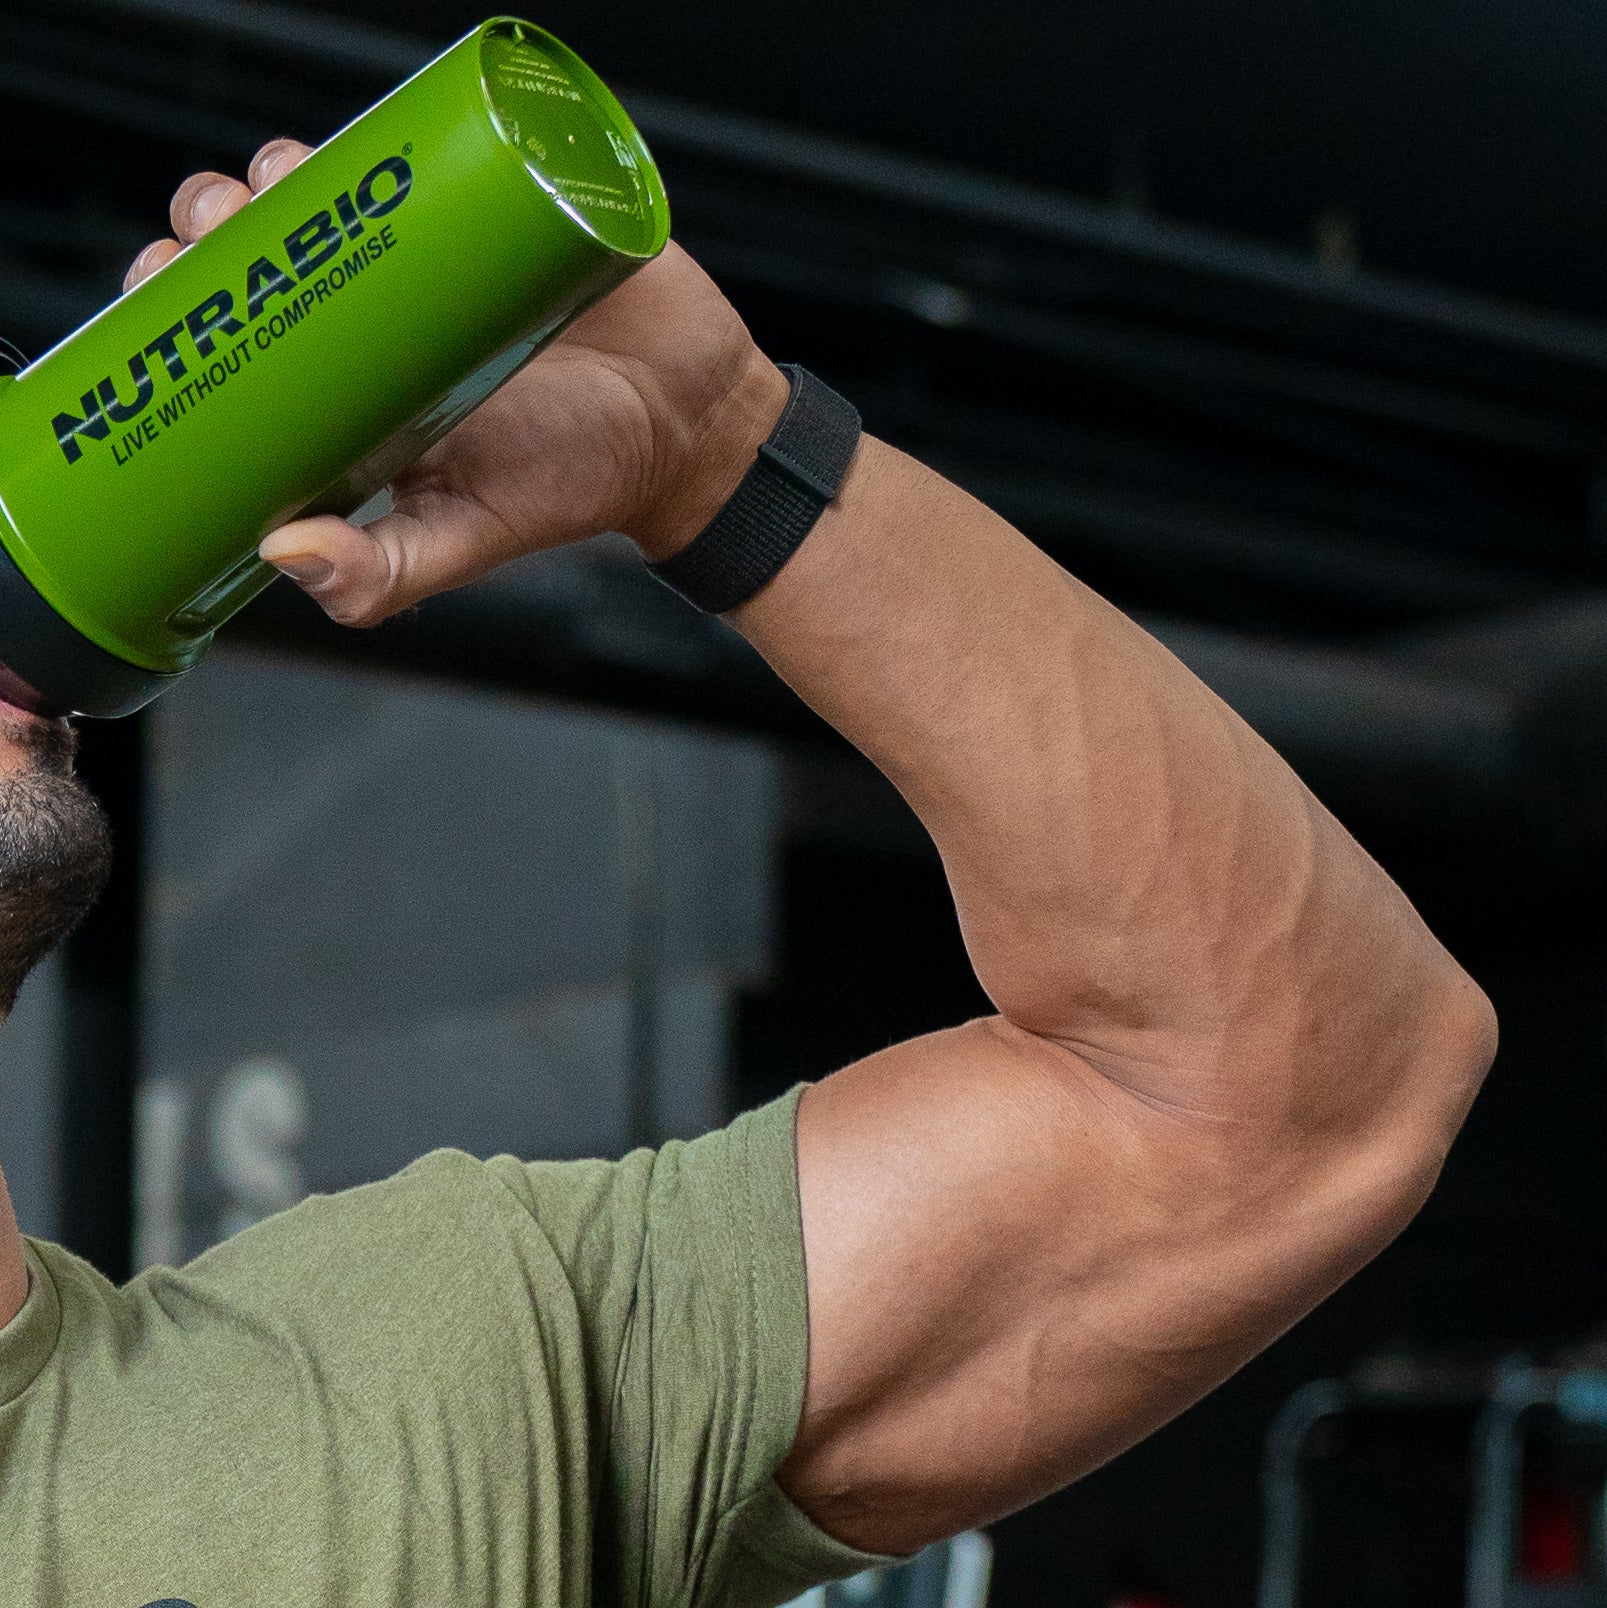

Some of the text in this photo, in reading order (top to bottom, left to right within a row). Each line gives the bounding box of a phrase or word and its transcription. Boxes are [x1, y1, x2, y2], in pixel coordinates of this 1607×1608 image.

[111, 224, 398, 466] LIVE WITHOUT COMPROMISE
